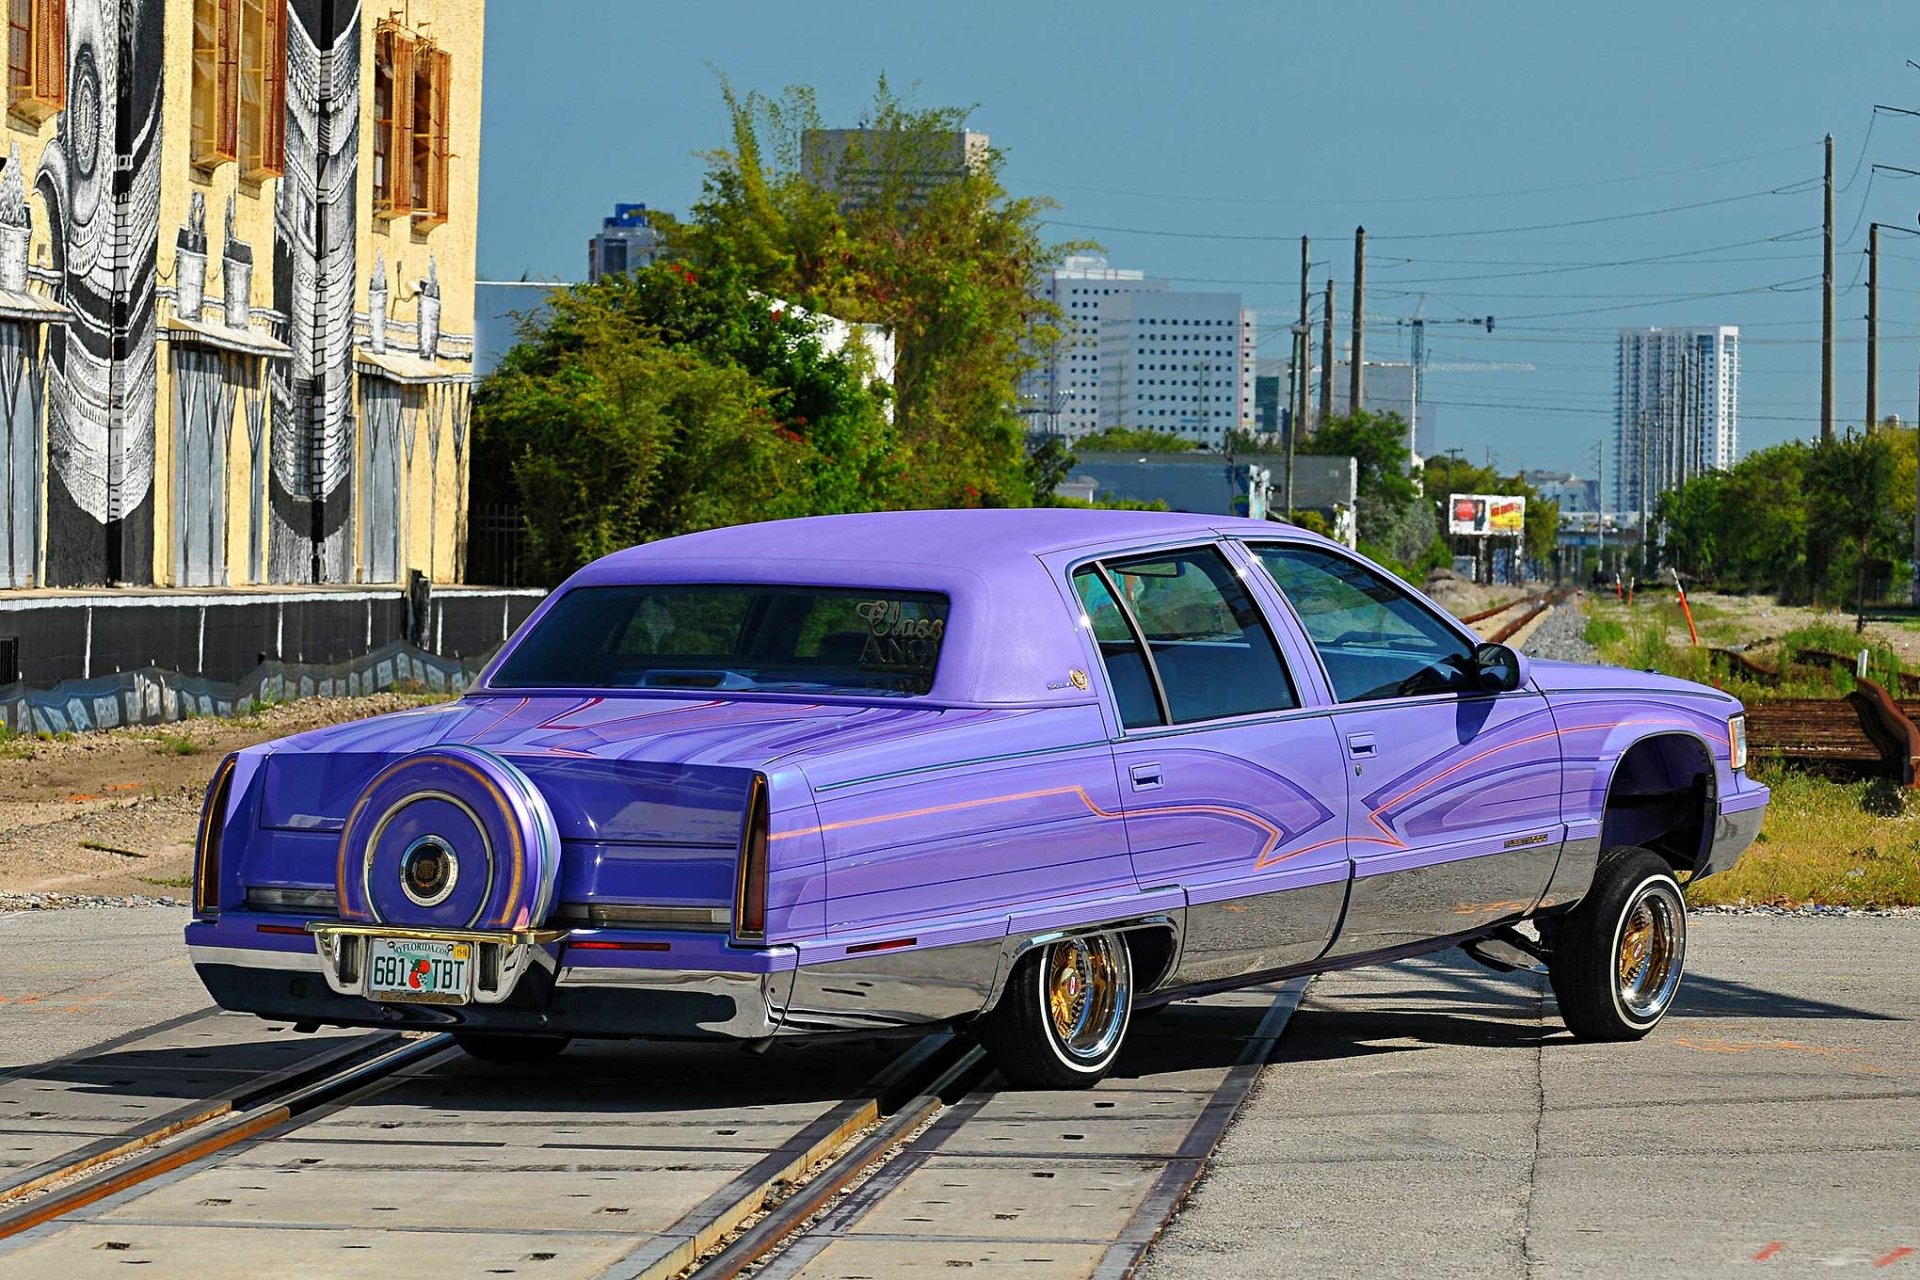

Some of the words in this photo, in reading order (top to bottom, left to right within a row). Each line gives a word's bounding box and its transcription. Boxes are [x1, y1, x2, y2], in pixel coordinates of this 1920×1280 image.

[856, 600, 944, 638] Class
[375, 957, 406, 986] 681
[432, 959, 464, 989] TBT
